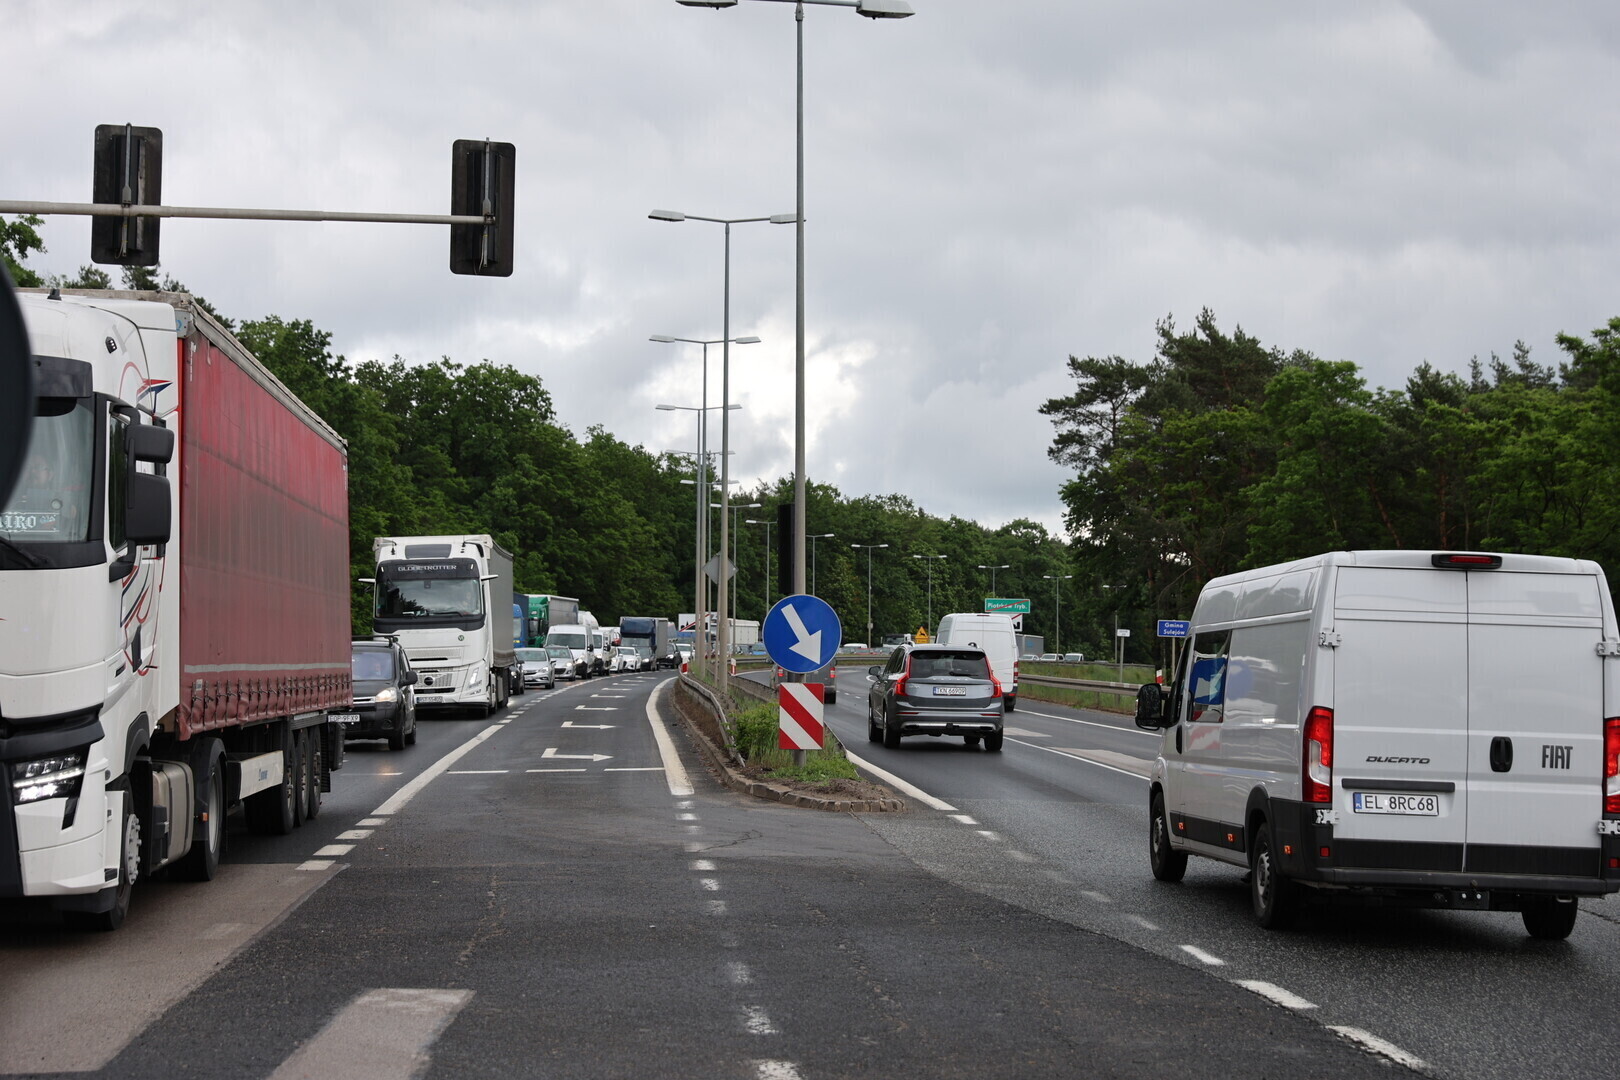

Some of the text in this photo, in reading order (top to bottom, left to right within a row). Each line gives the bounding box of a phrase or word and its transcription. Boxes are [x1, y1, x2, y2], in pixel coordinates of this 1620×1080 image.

[1365, 755, 1430, 765] DUCATO
[1542, 745, 1573, 770] FIAT
[1364, 795, 1434, 811] EL 8RC68
